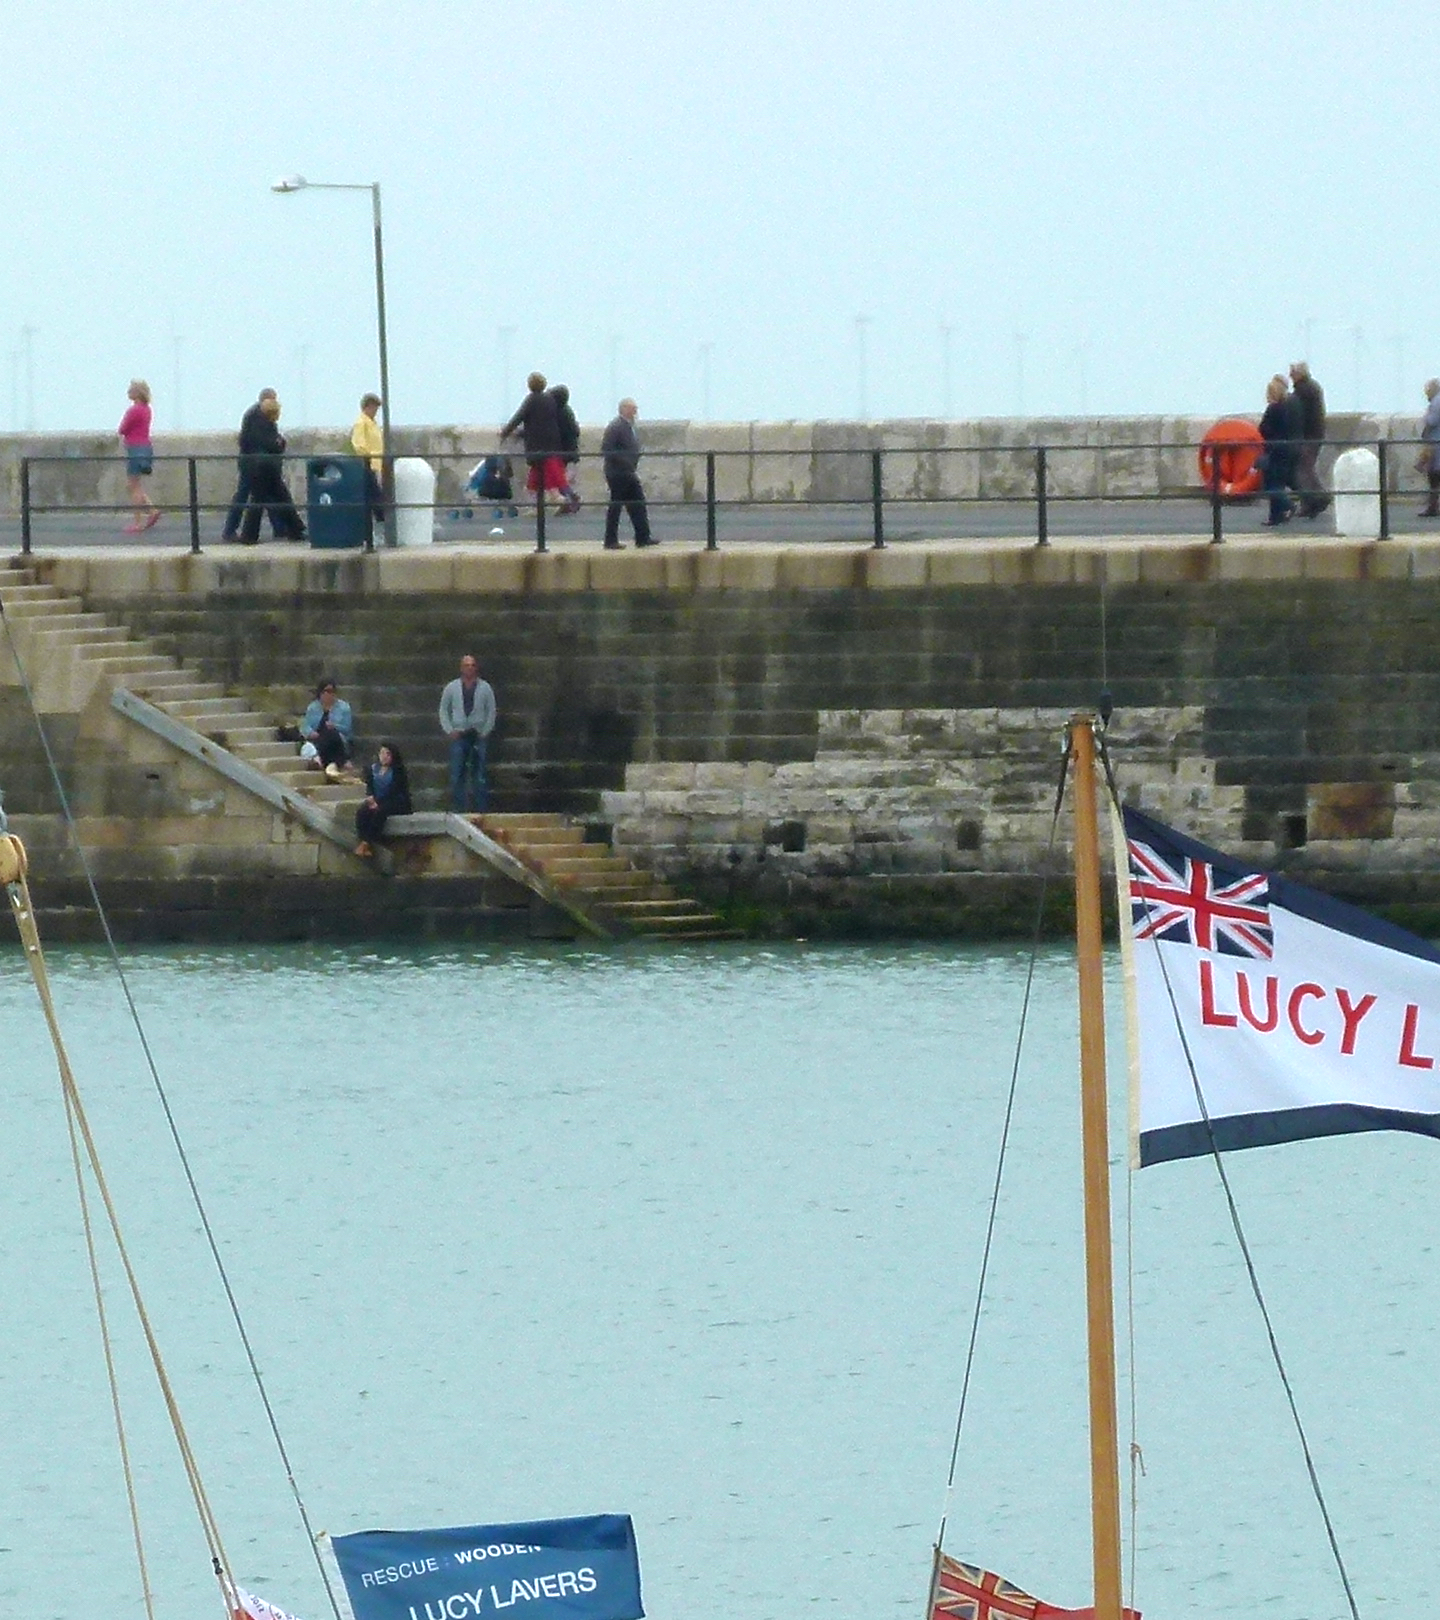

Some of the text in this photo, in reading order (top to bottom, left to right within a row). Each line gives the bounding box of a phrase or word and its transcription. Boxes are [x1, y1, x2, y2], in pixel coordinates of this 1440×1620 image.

[1200, 959, 1378, 1055] LUCY
[361, 1557, 440, 1588] RESCUE
[490, 1567, 597, 1609] LAVERS
